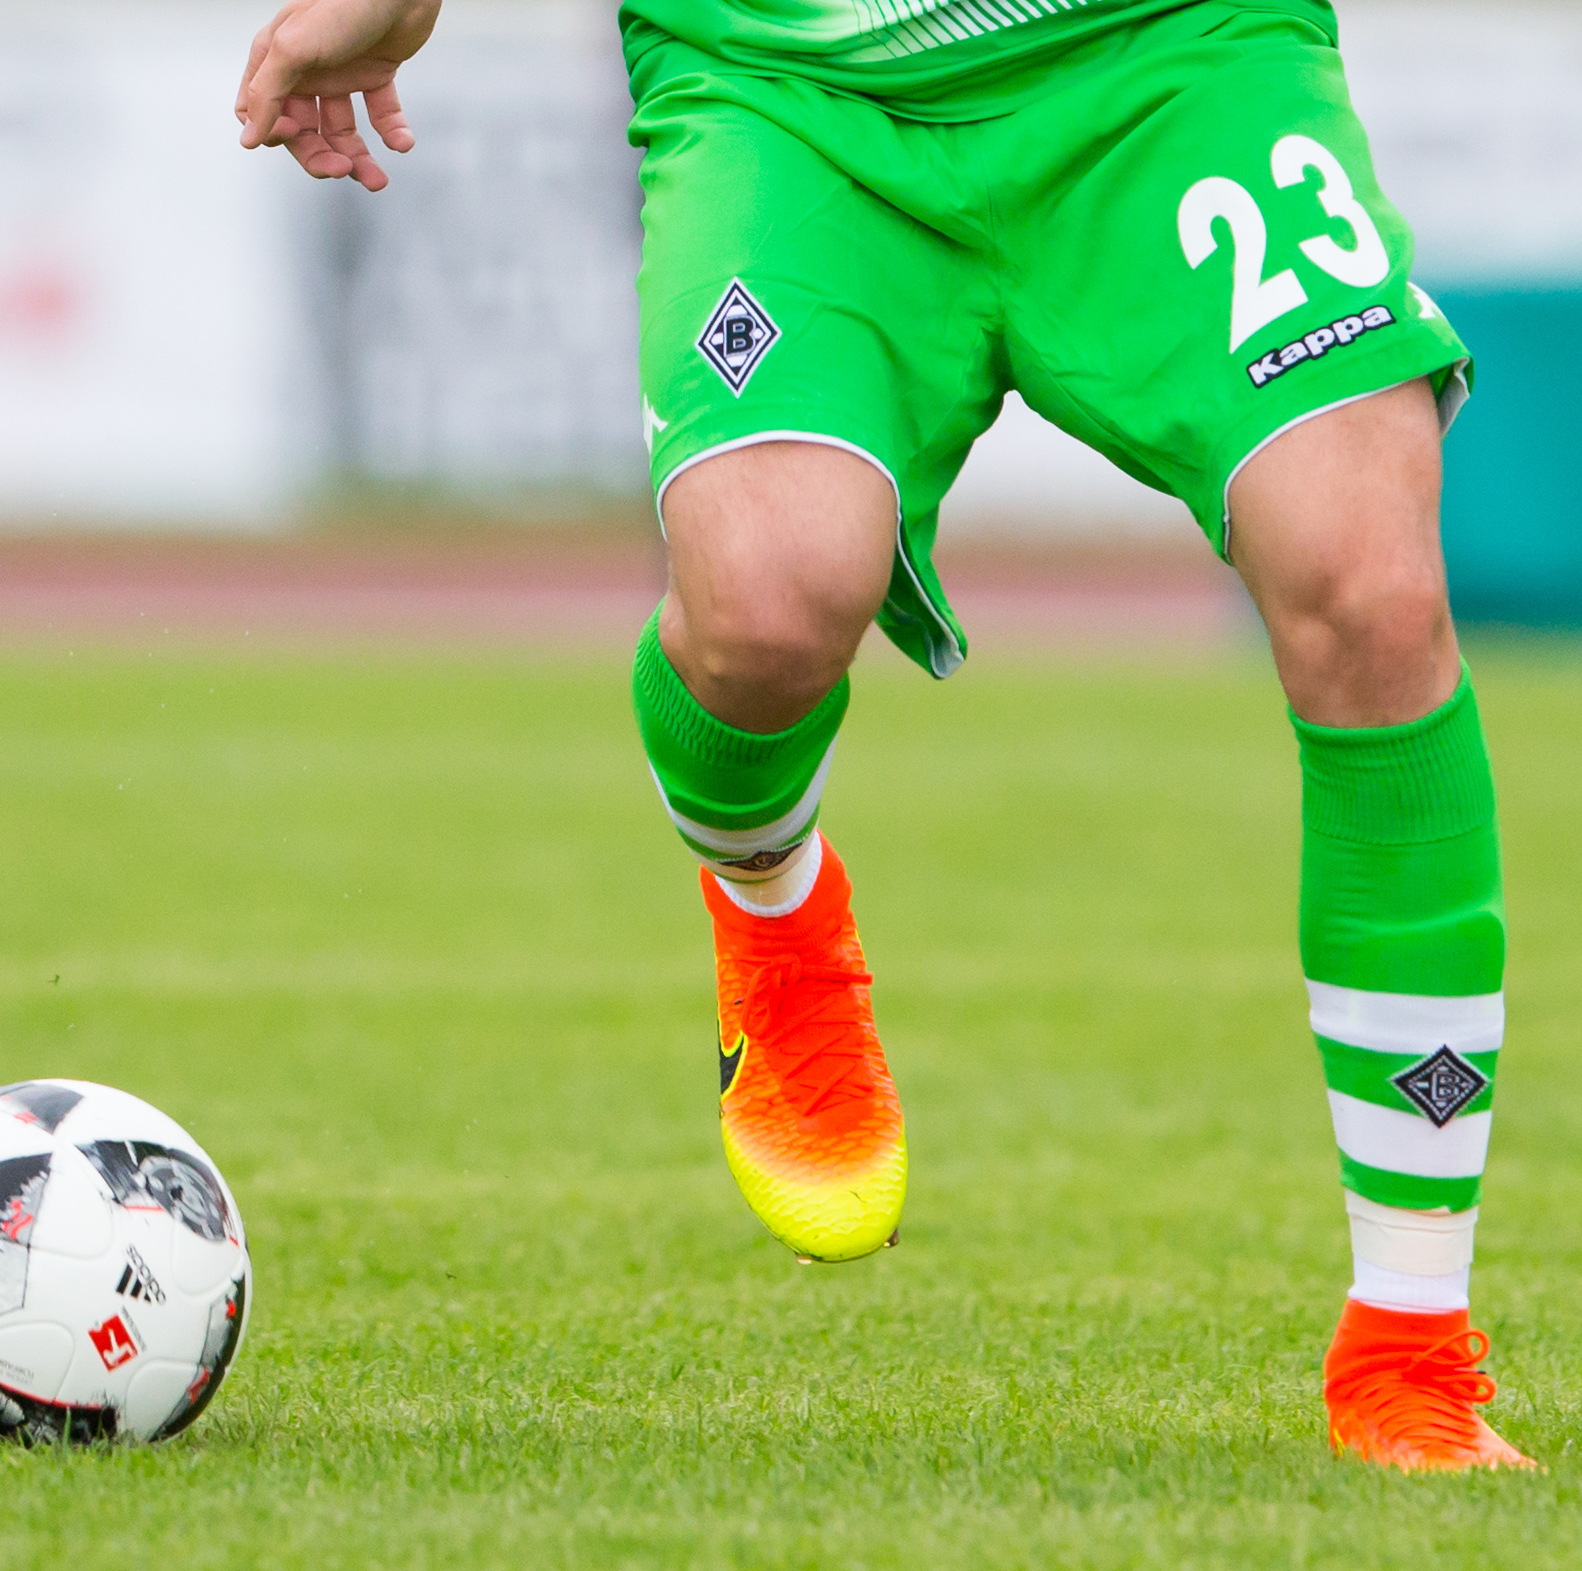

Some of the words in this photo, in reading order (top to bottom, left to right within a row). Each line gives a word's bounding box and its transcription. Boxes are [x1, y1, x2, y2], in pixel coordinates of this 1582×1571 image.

[1176, 134, 1391, 355] 23
[722, 314, 757, 359] B
[1247, 305, 1394, 386] Kappa
